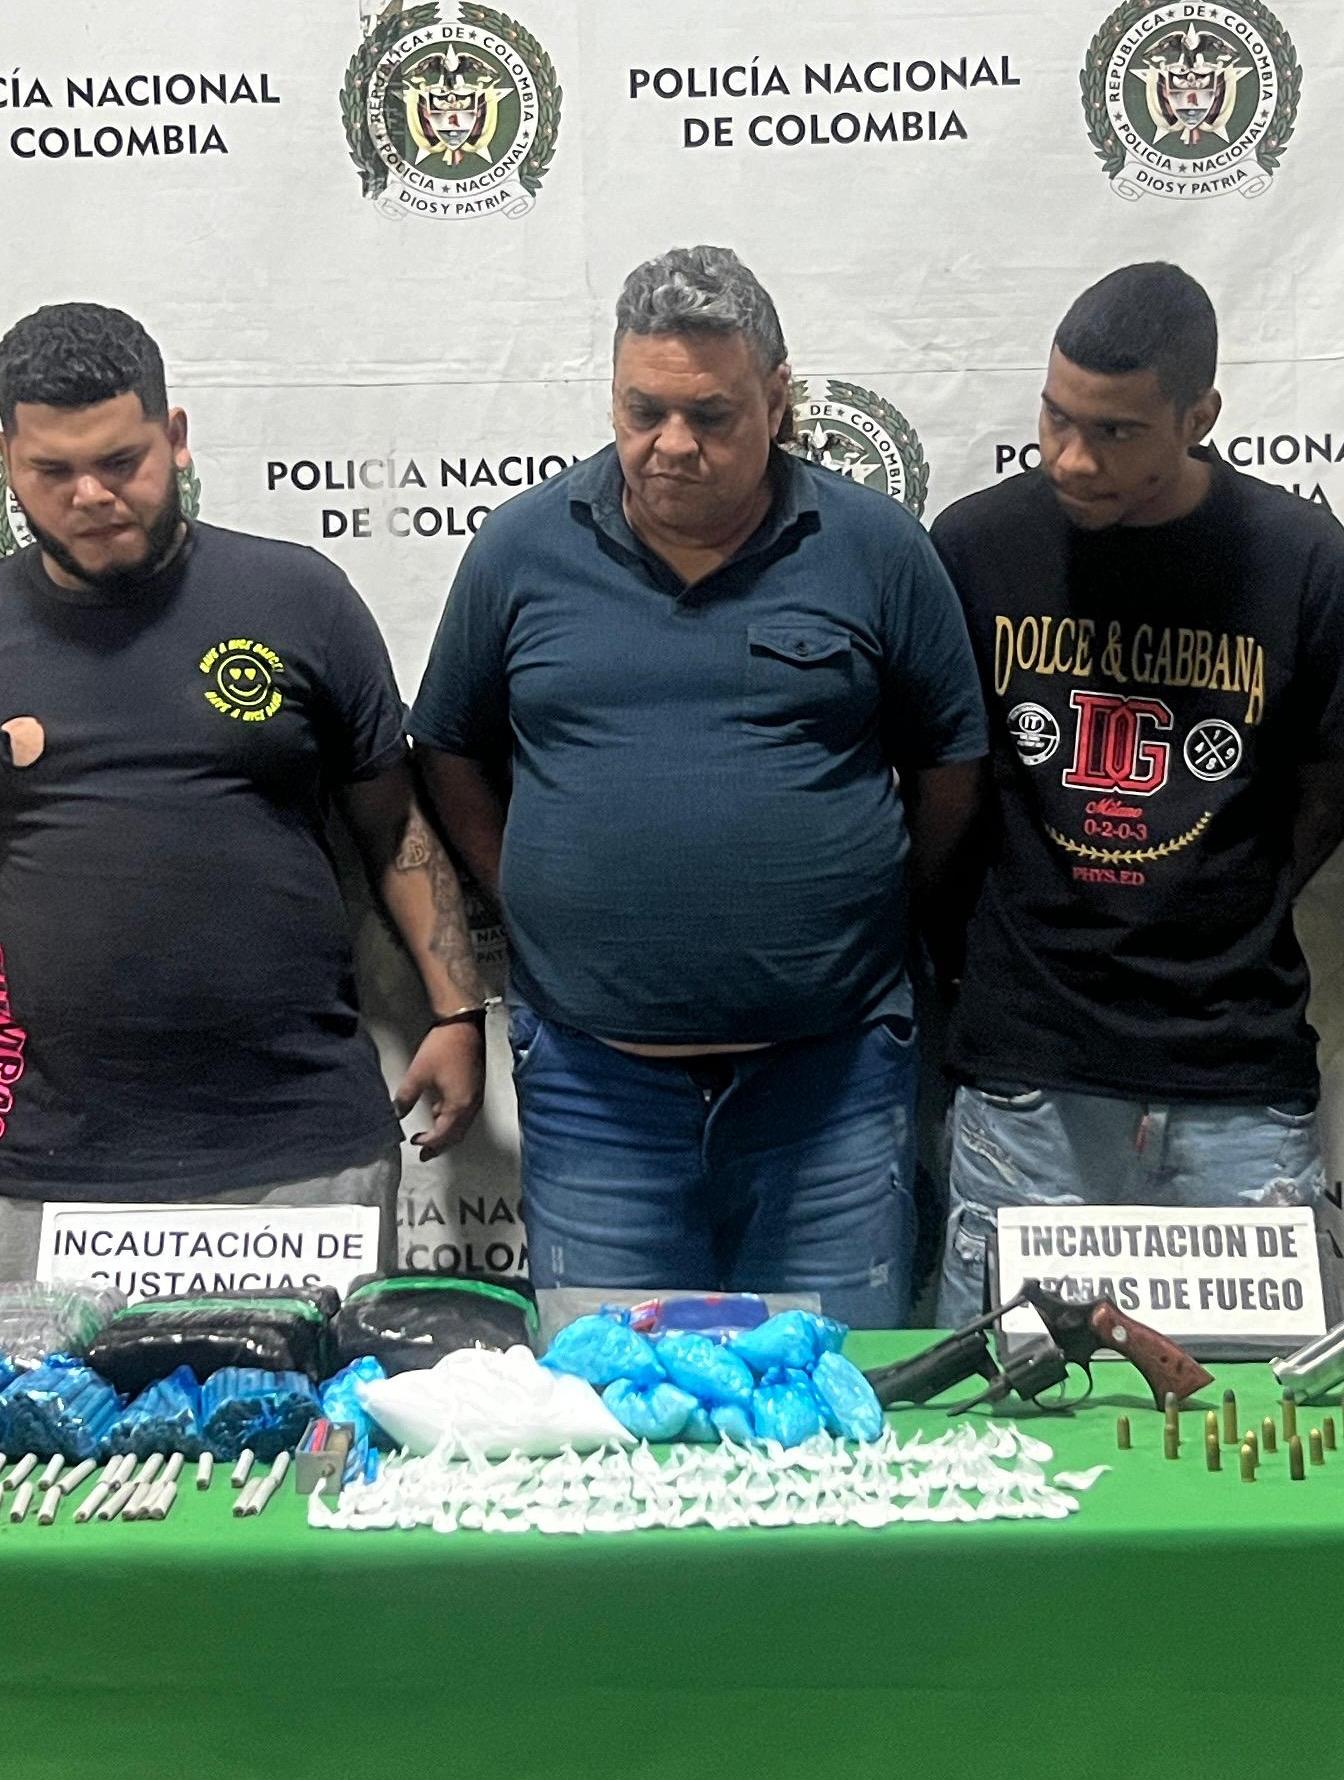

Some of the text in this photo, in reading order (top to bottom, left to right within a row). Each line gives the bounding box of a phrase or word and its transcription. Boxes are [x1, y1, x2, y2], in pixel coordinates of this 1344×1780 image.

[1110, 5, 1273, 102] REPUBLICA DE COLOMBIA
[67, 73, 281, 108] NACIONAL
[442, 27, 465, 39] DE
[483, 37, 534, 122] COLOMBIA
[629, 55, 1021, 99] POLICÍA NACIONAL
[10, 124, 229, 158] COLOMBIA
[684, 109, 968, 148] DE COLOMBIA
[1118, 119, 1267, 173] POLICIA NACIONAL
[381, 141, 529, 194] POLICIA NACIONAL
[1136, 168, 1248, 195] DIOS Y PATRIA
[398, 189, 511, 215] DIOS Y PATRIA
[810, 405, 901, 497] DE COLOMBIA
[322, 507, 372, 539] DE
[995, 615, 1265, 726] DOLCE & GABBANA
[53, 1225, 365, 1260] INCAUTACIÓN DE
[1020, 1223, 1248, 1257] INCAUTACION
[1257, 1224, 1299, 1258] DE
[1149, 1277, 1191, 1310] DE
[1198, 1277, 1304, 1311] FUEGO
